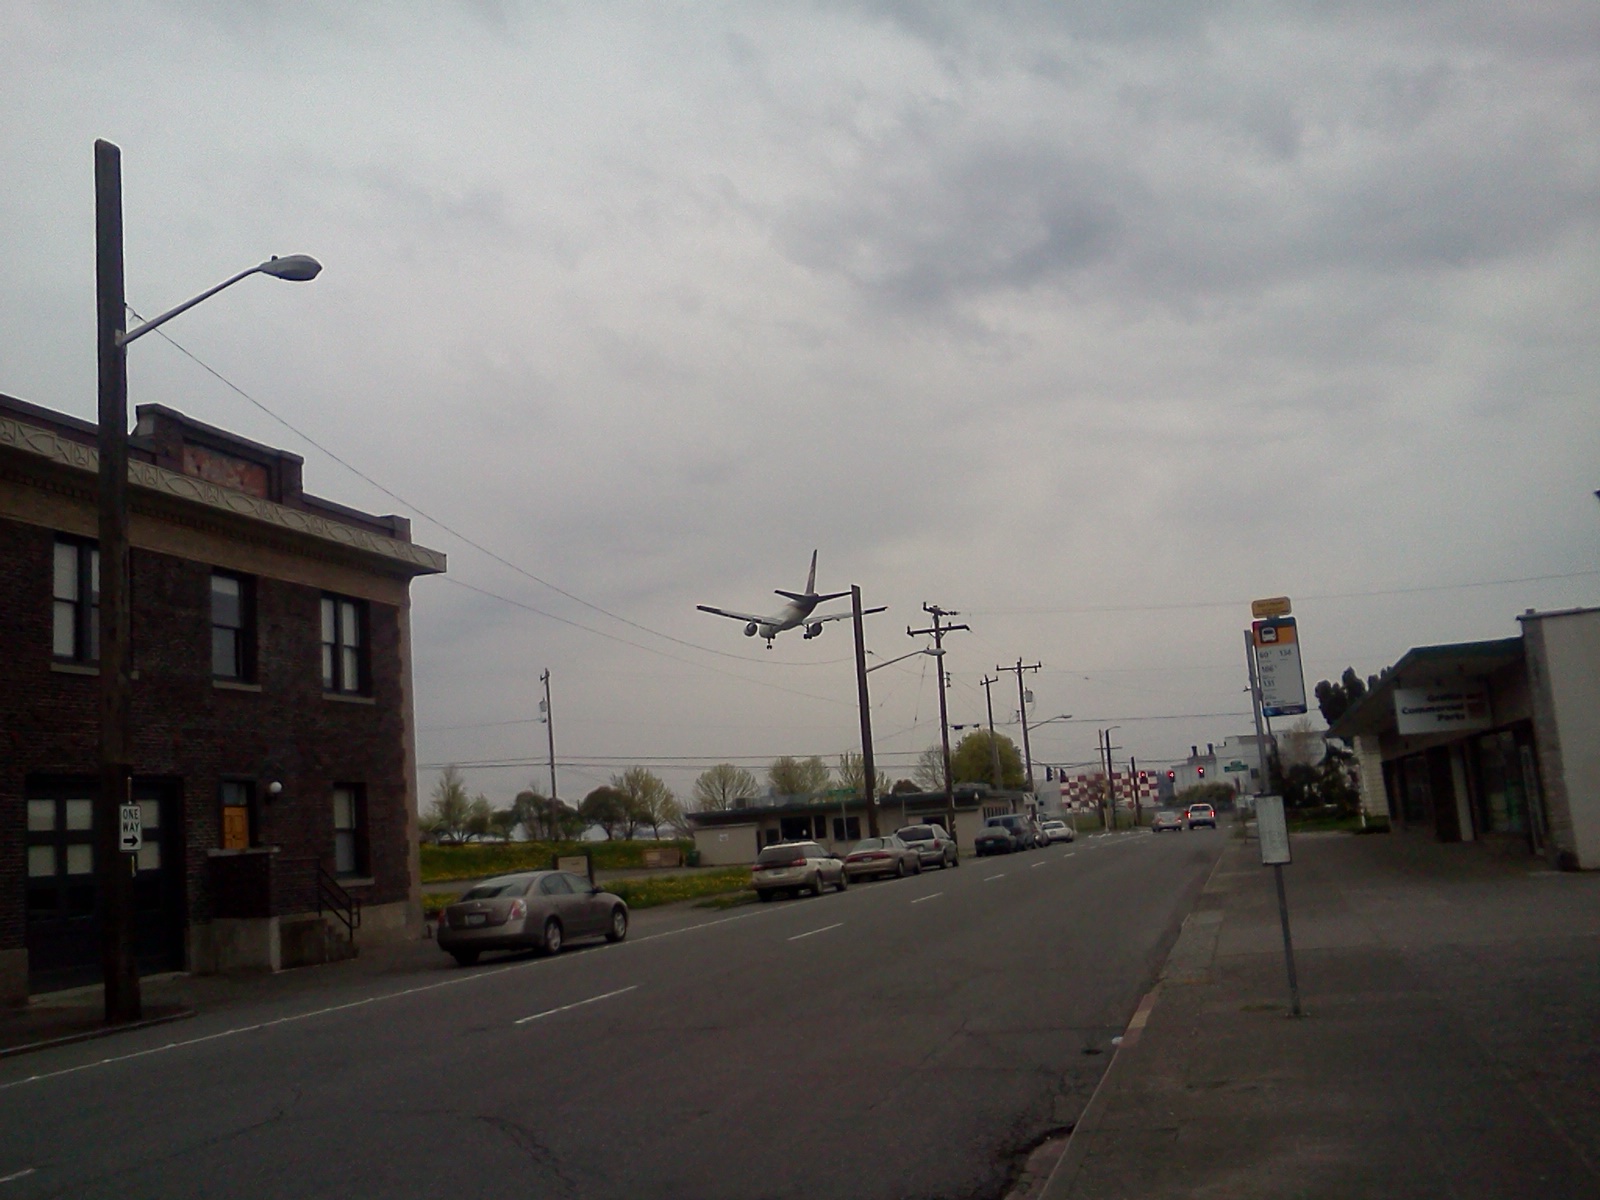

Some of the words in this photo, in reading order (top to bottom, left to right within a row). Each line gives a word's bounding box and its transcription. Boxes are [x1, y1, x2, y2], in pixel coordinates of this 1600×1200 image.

[1402, 704, 1464, 714] Commercial
[123, 809, 138, 820] ONE
[123, 822, 139, 832] WAY
